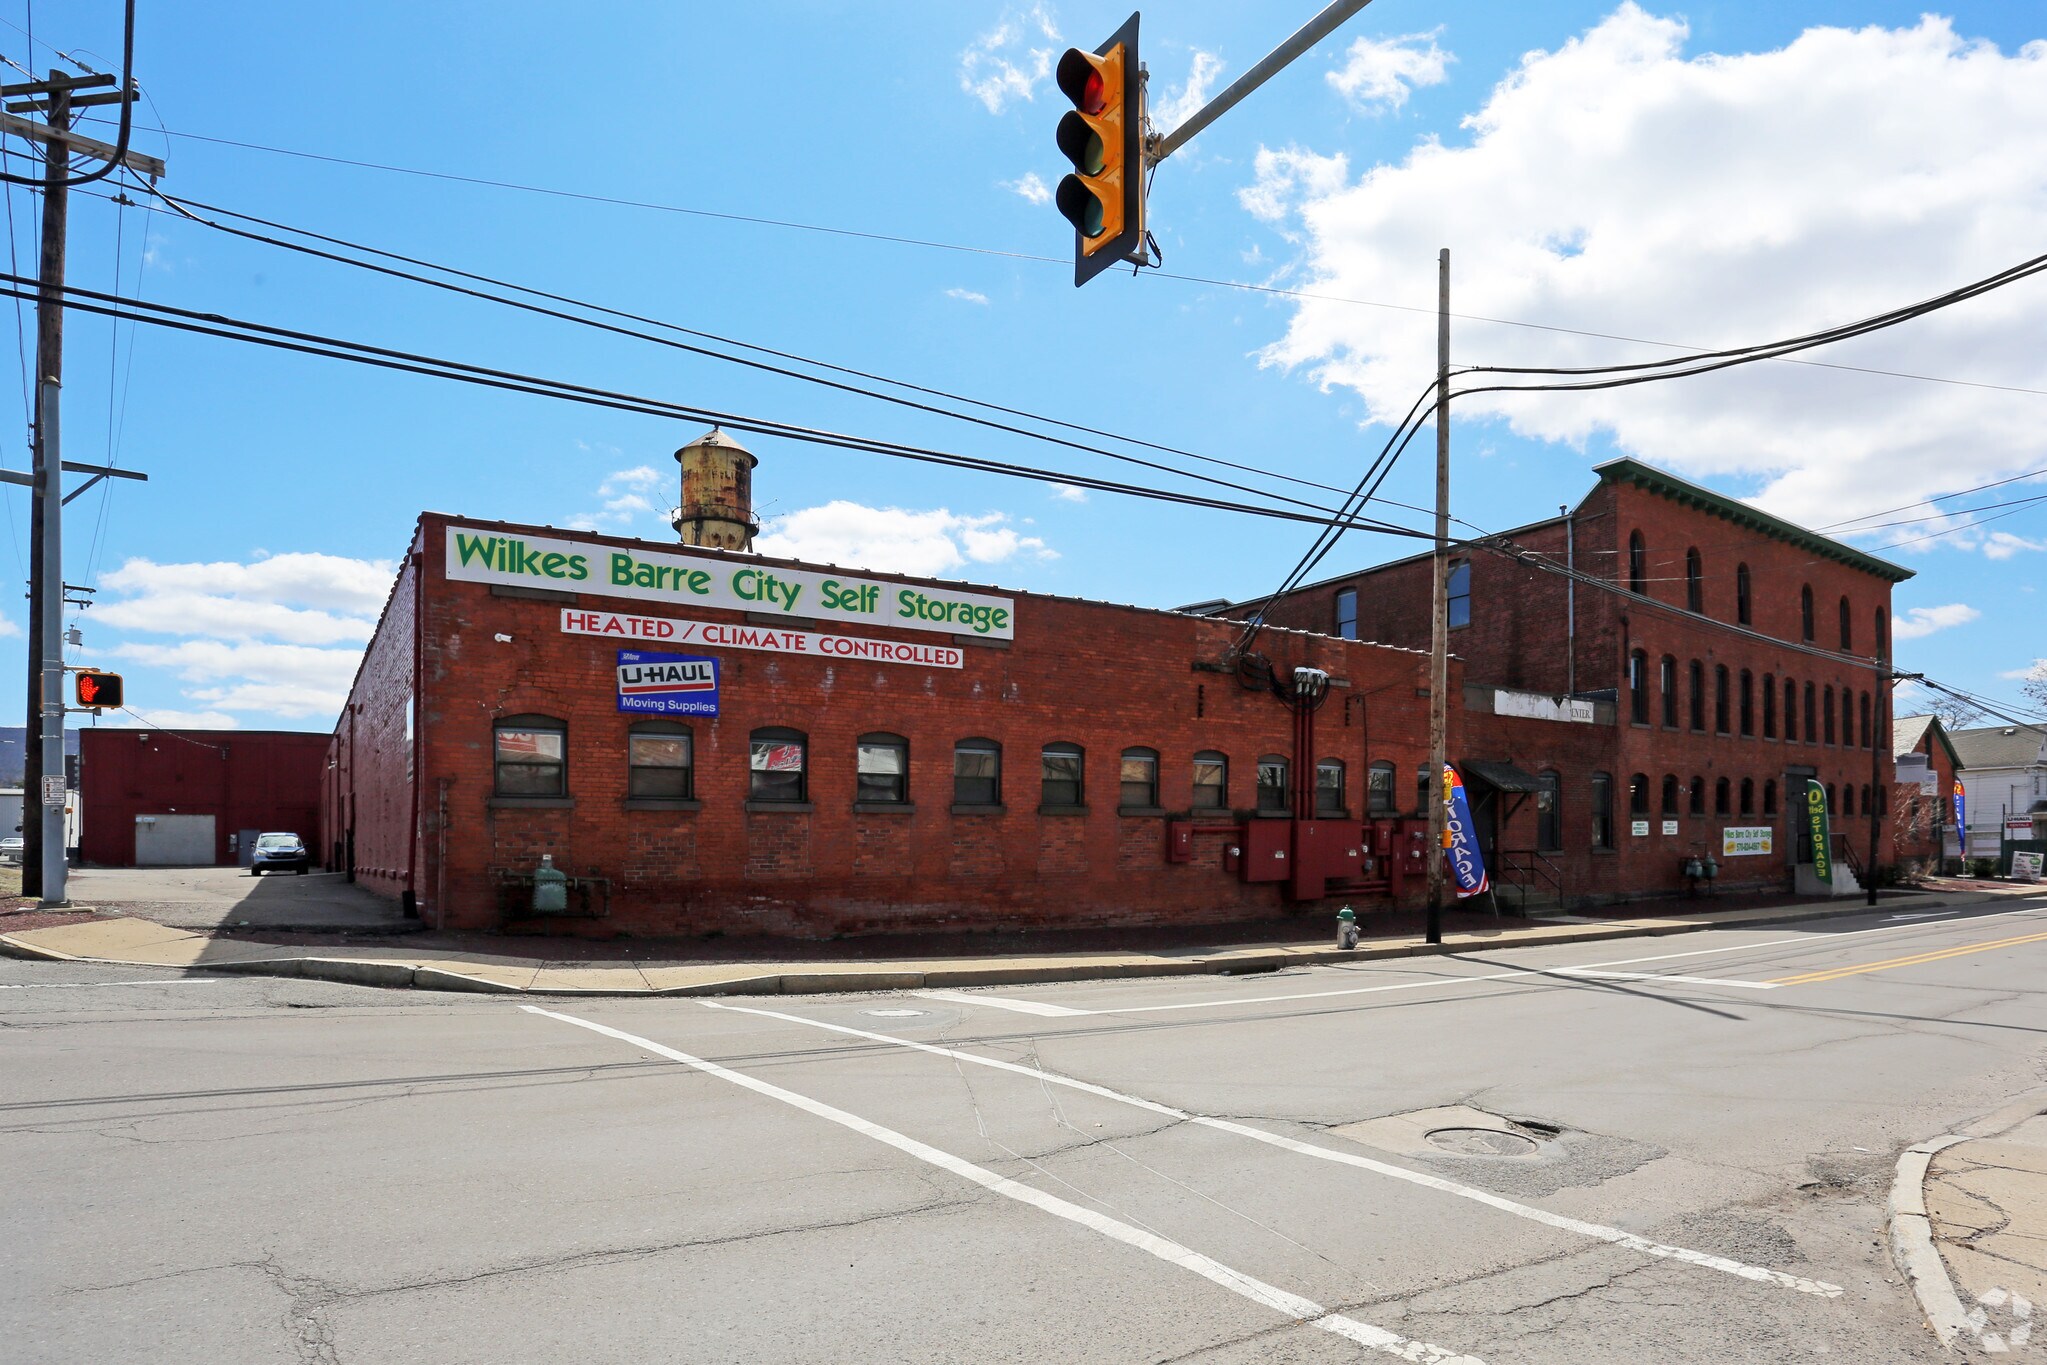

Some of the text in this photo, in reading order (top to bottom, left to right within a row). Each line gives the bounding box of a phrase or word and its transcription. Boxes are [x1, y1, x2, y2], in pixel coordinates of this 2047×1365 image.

[456, 533, 1009, 633] Wilkes Barre City Self Storage
[566, 612, 674, 638] HEATED
[702, 625, 807, 651] CLIMATE
[818, 637, 960, 665] CONTROLLED
[621, 664, 711, 684] U-HAUL
[622, 697, 716, 713] Moving Supplies
